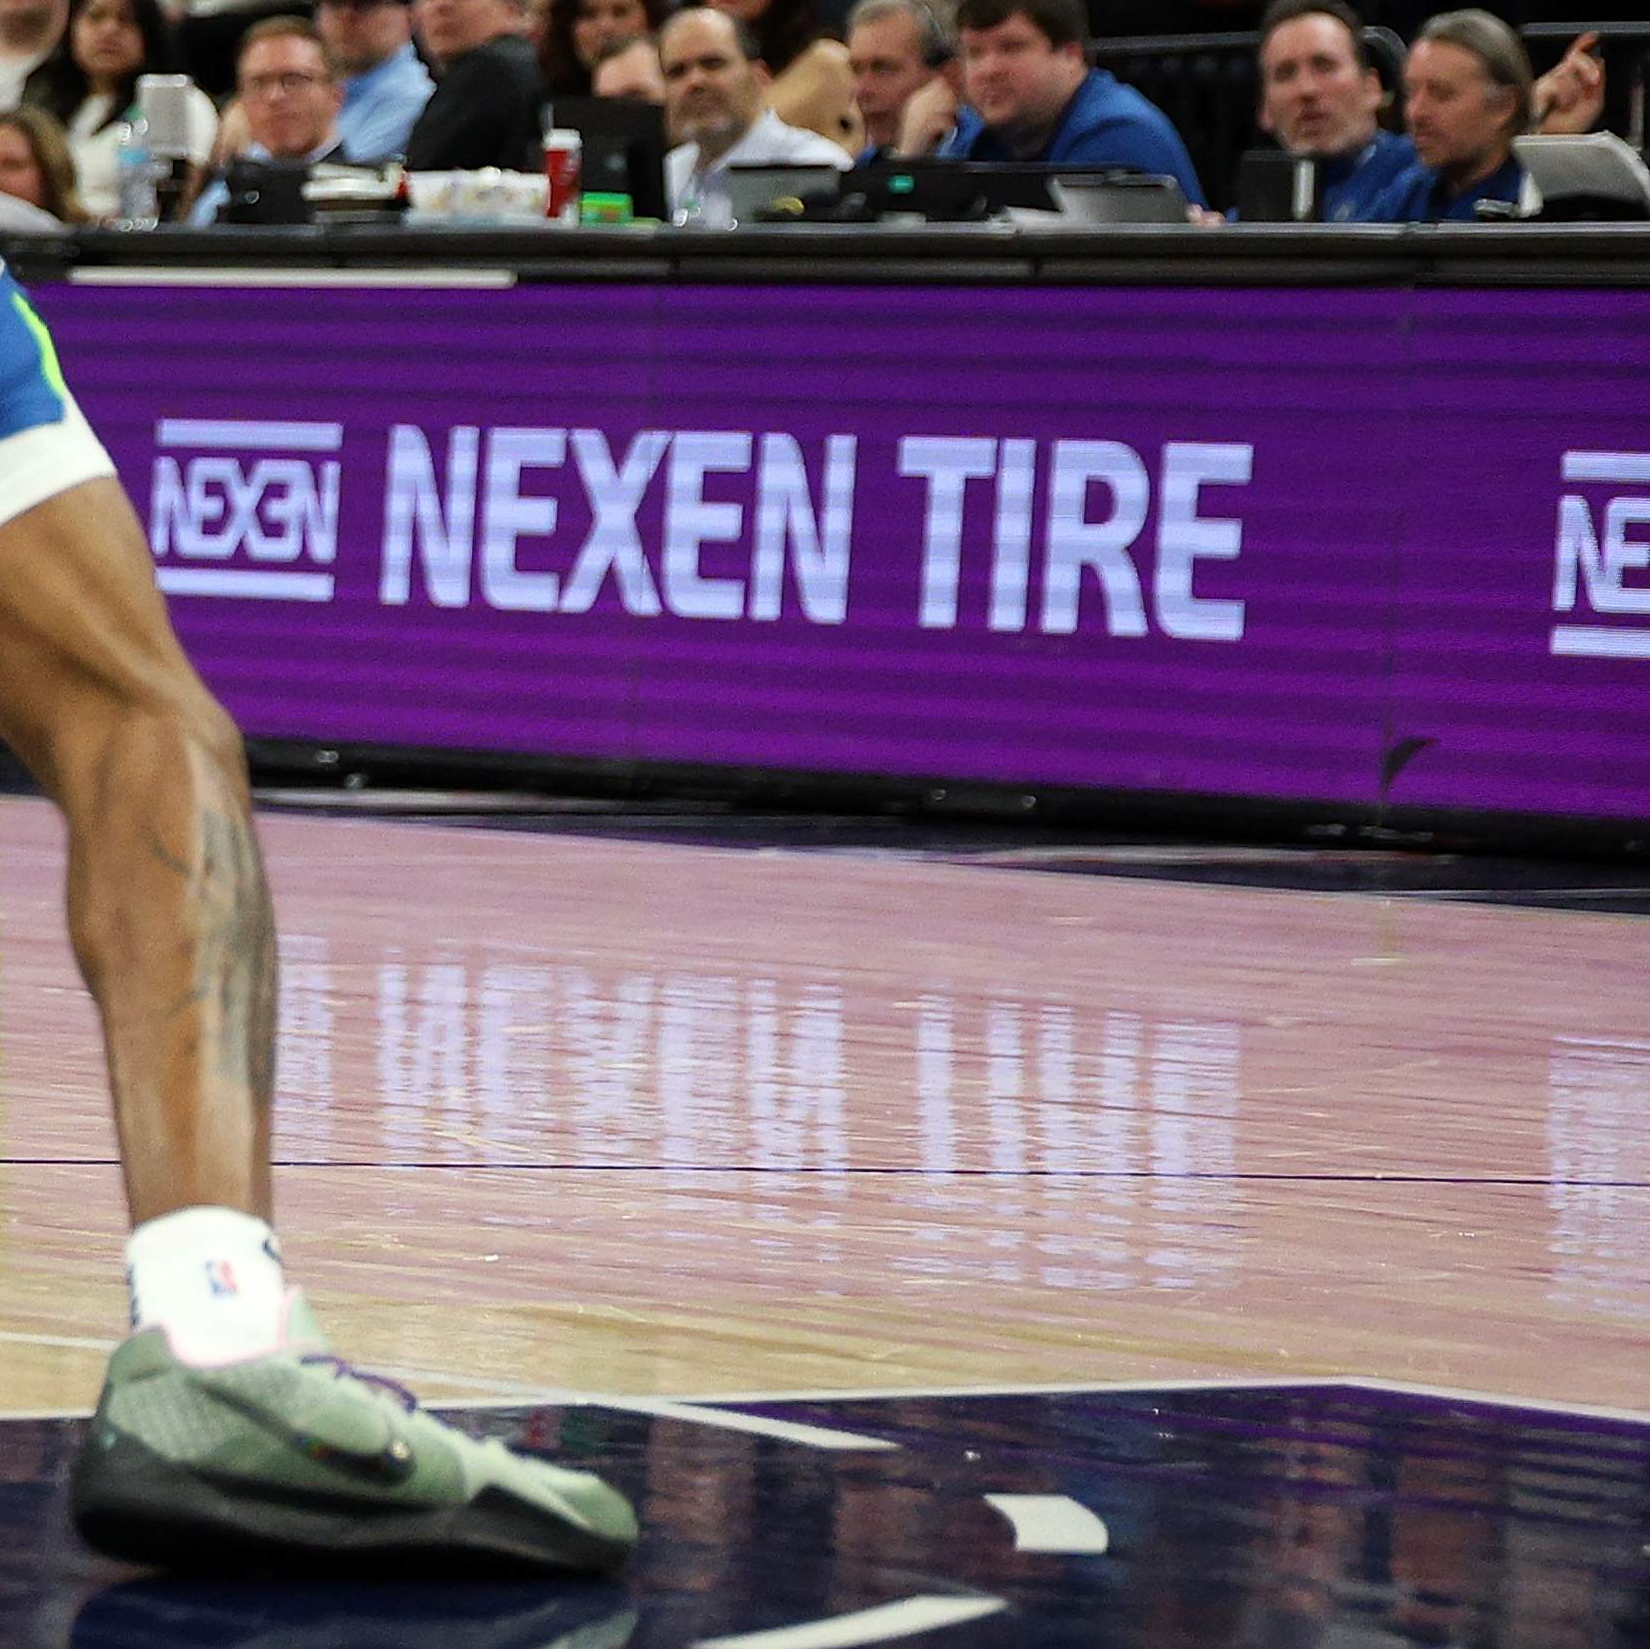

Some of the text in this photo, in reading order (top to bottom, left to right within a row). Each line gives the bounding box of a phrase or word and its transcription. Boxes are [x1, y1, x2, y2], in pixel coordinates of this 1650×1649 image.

[152, 456, 342, 564] NEXEN
[378, 423, 1255, 642] NEXEN TIRE
